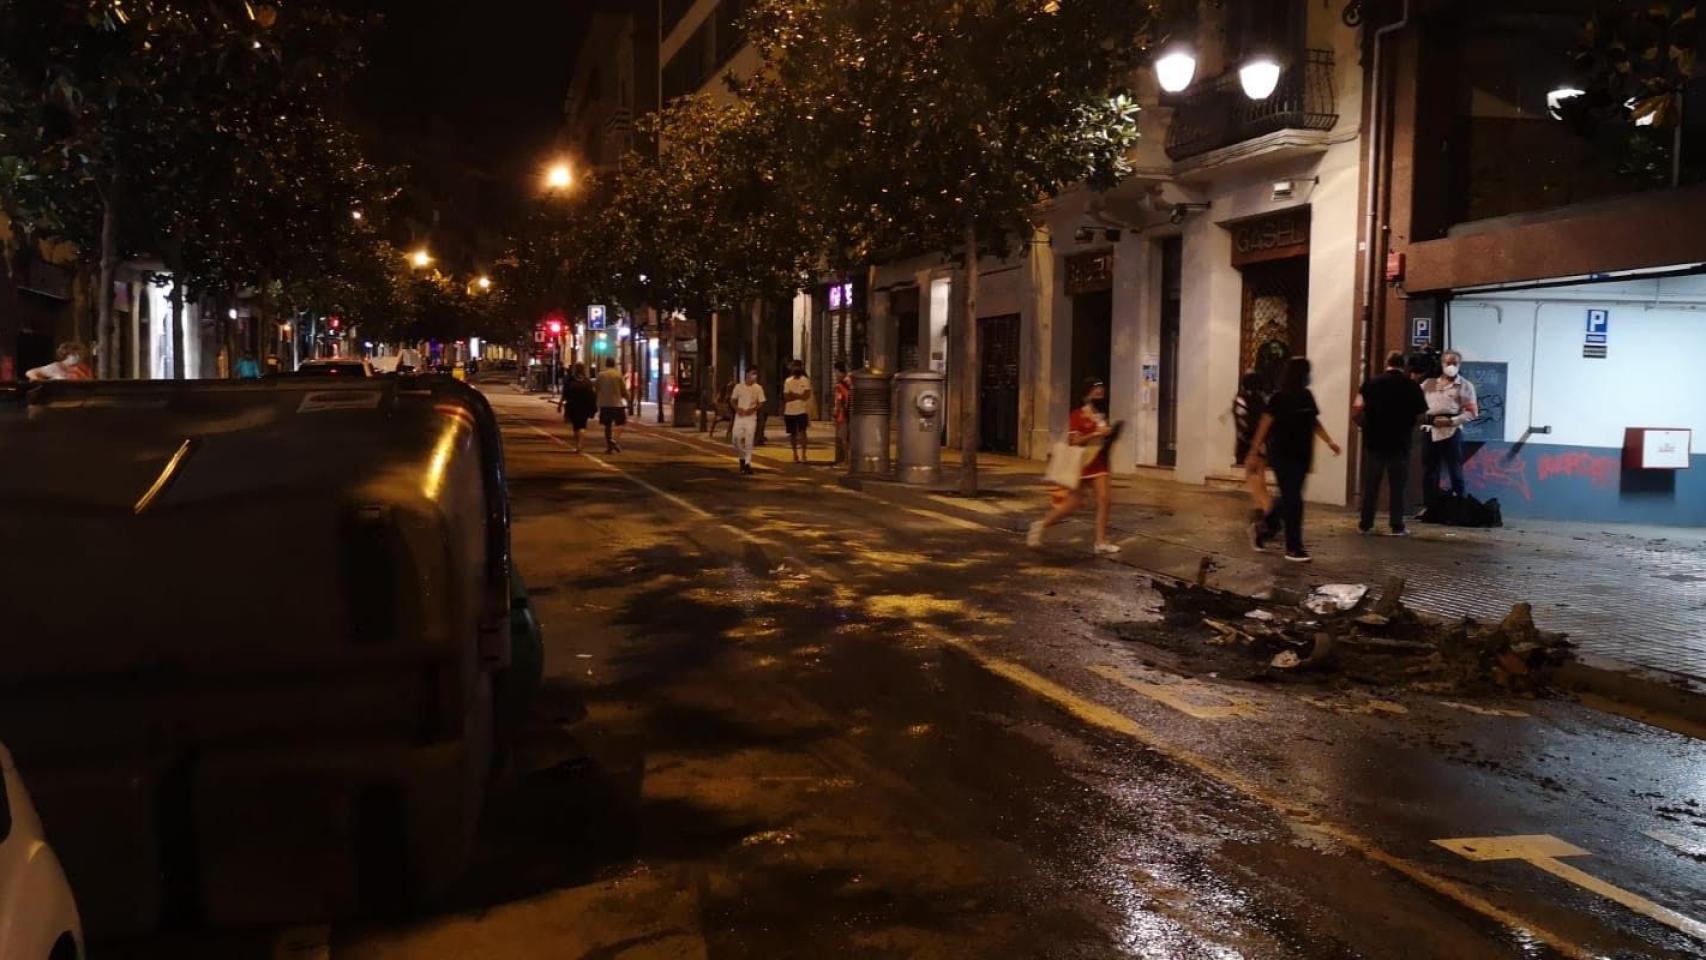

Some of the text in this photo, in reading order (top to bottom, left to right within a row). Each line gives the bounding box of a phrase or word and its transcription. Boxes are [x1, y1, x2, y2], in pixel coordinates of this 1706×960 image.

[591, 307, 602, 321] P
[1590, 311, 1605, 332] P
[1417, 320, 1427, 336] P
